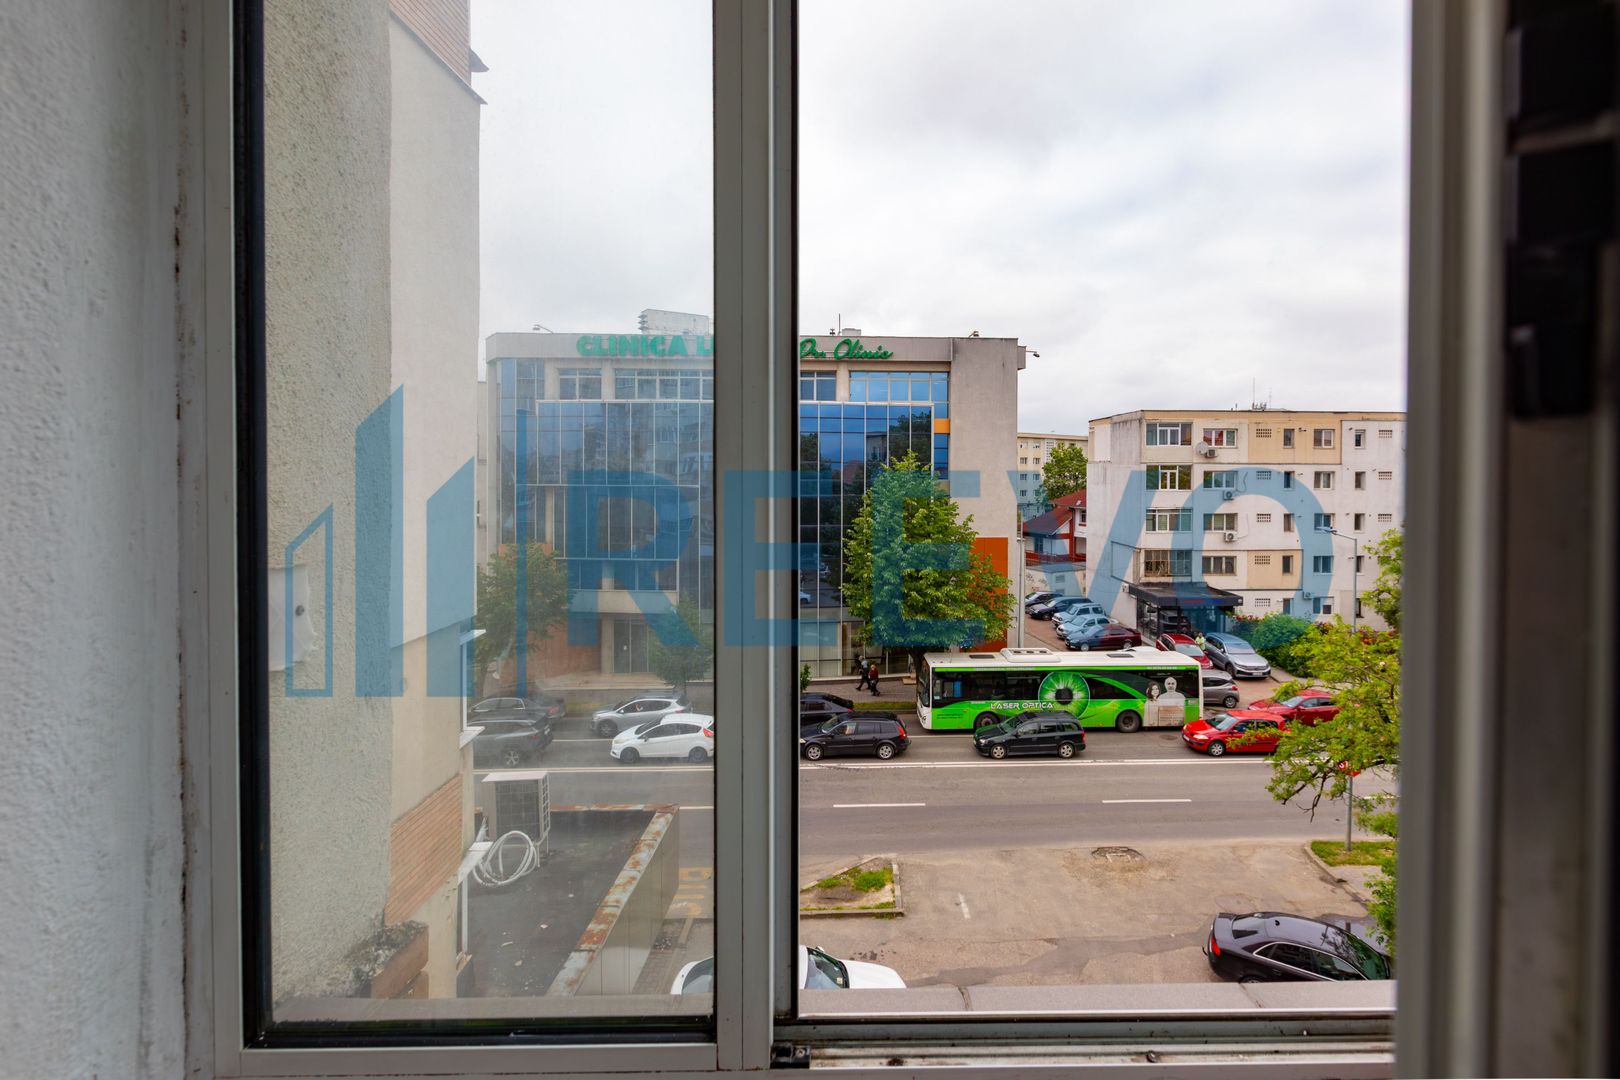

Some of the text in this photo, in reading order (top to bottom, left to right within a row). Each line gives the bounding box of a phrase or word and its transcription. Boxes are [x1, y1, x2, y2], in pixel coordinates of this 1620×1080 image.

[576, 335, 687, 357] CLINICA
[990, 702, 1021, 711] LASER
[1022, 702, 1054, 710] OPTICA
